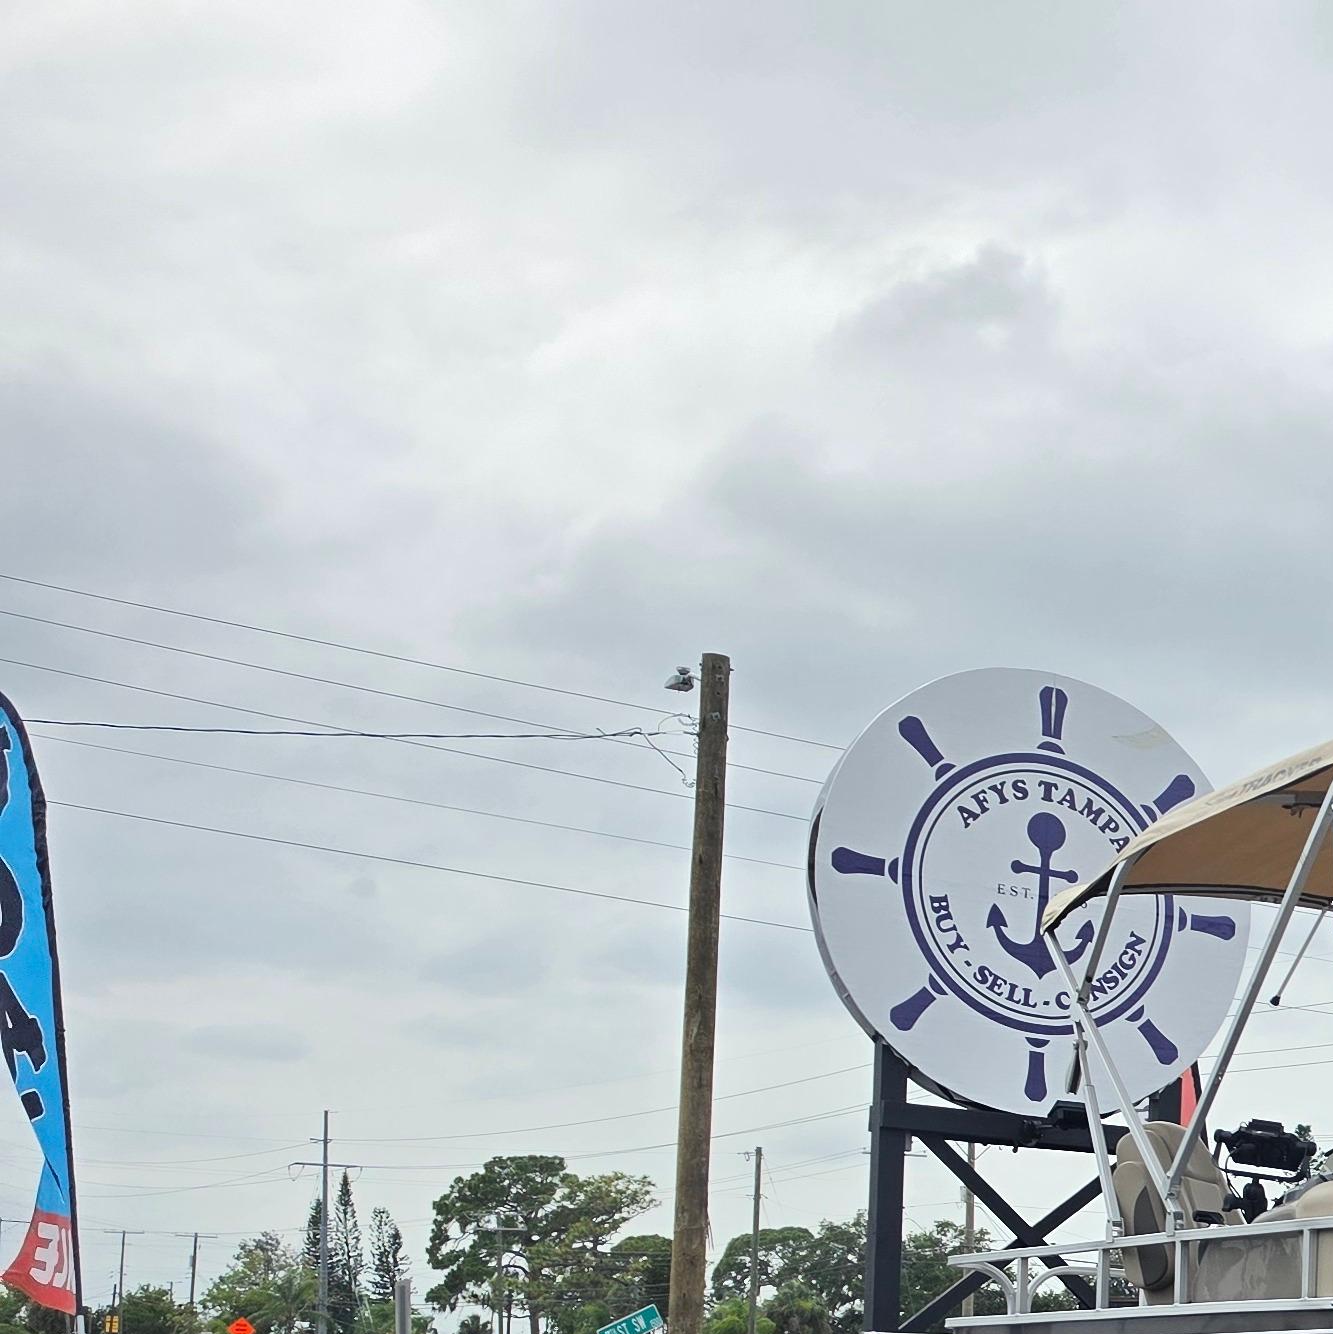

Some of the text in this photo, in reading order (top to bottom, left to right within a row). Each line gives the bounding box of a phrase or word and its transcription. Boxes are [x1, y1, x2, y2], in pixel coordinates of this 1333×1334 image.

[957, 779, 1030, 829] AFYS
[1037, 779, 1132, 854] TAMPA
[996, 883, 1034, 900] EST.
[929, 893, 970, 955] BUY
[973, 965, 1038, 1010] SELL
[1054, 930, 1147, 1011] CNSIGN
[631, 1314, 647, 1332] SW
